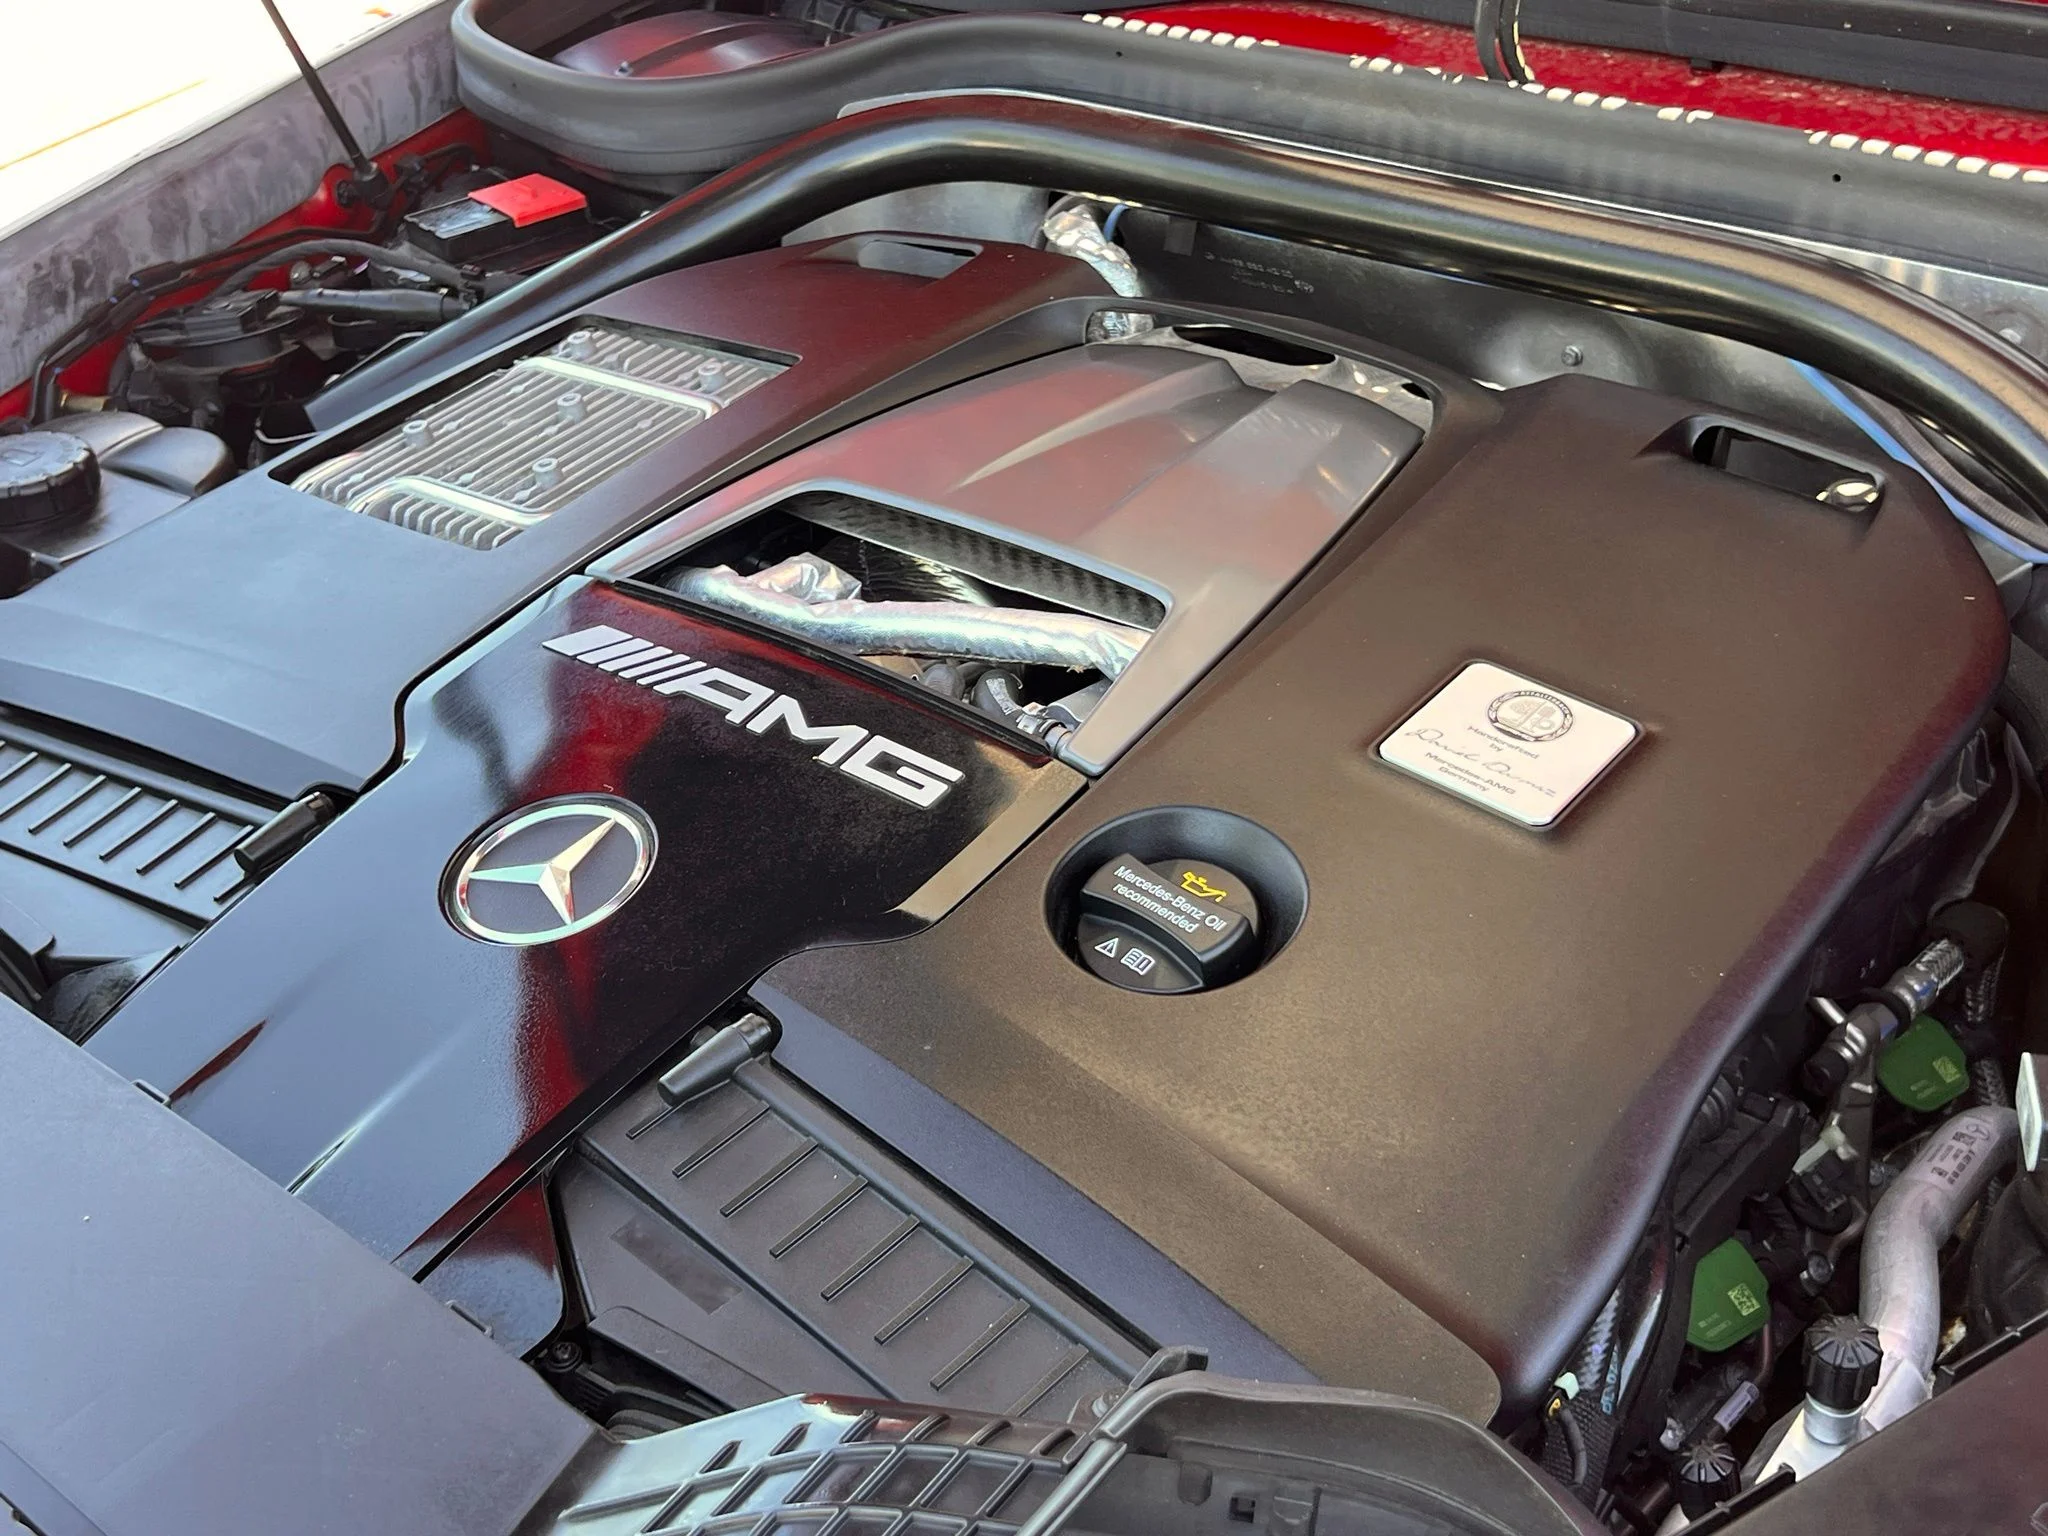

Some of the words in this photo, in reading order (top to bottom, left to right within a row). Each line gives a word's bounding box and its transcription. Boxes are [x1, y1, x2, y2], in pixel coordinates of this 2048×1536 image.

[653, 666, 965, 808] AMG
[1467, 725, 1540, 760] Handcrafted
[1489, 743, 1503, 752] by
[1425, 752, 1516, 795] Mercedes-AMG
[1438, 766, 1490, 792] Germany
[1112, 883, 1199, 934] recommended
[1113, 865, 1206, 922] Mercedes-Benz
[1204, 914, 1228, 932] Oil
